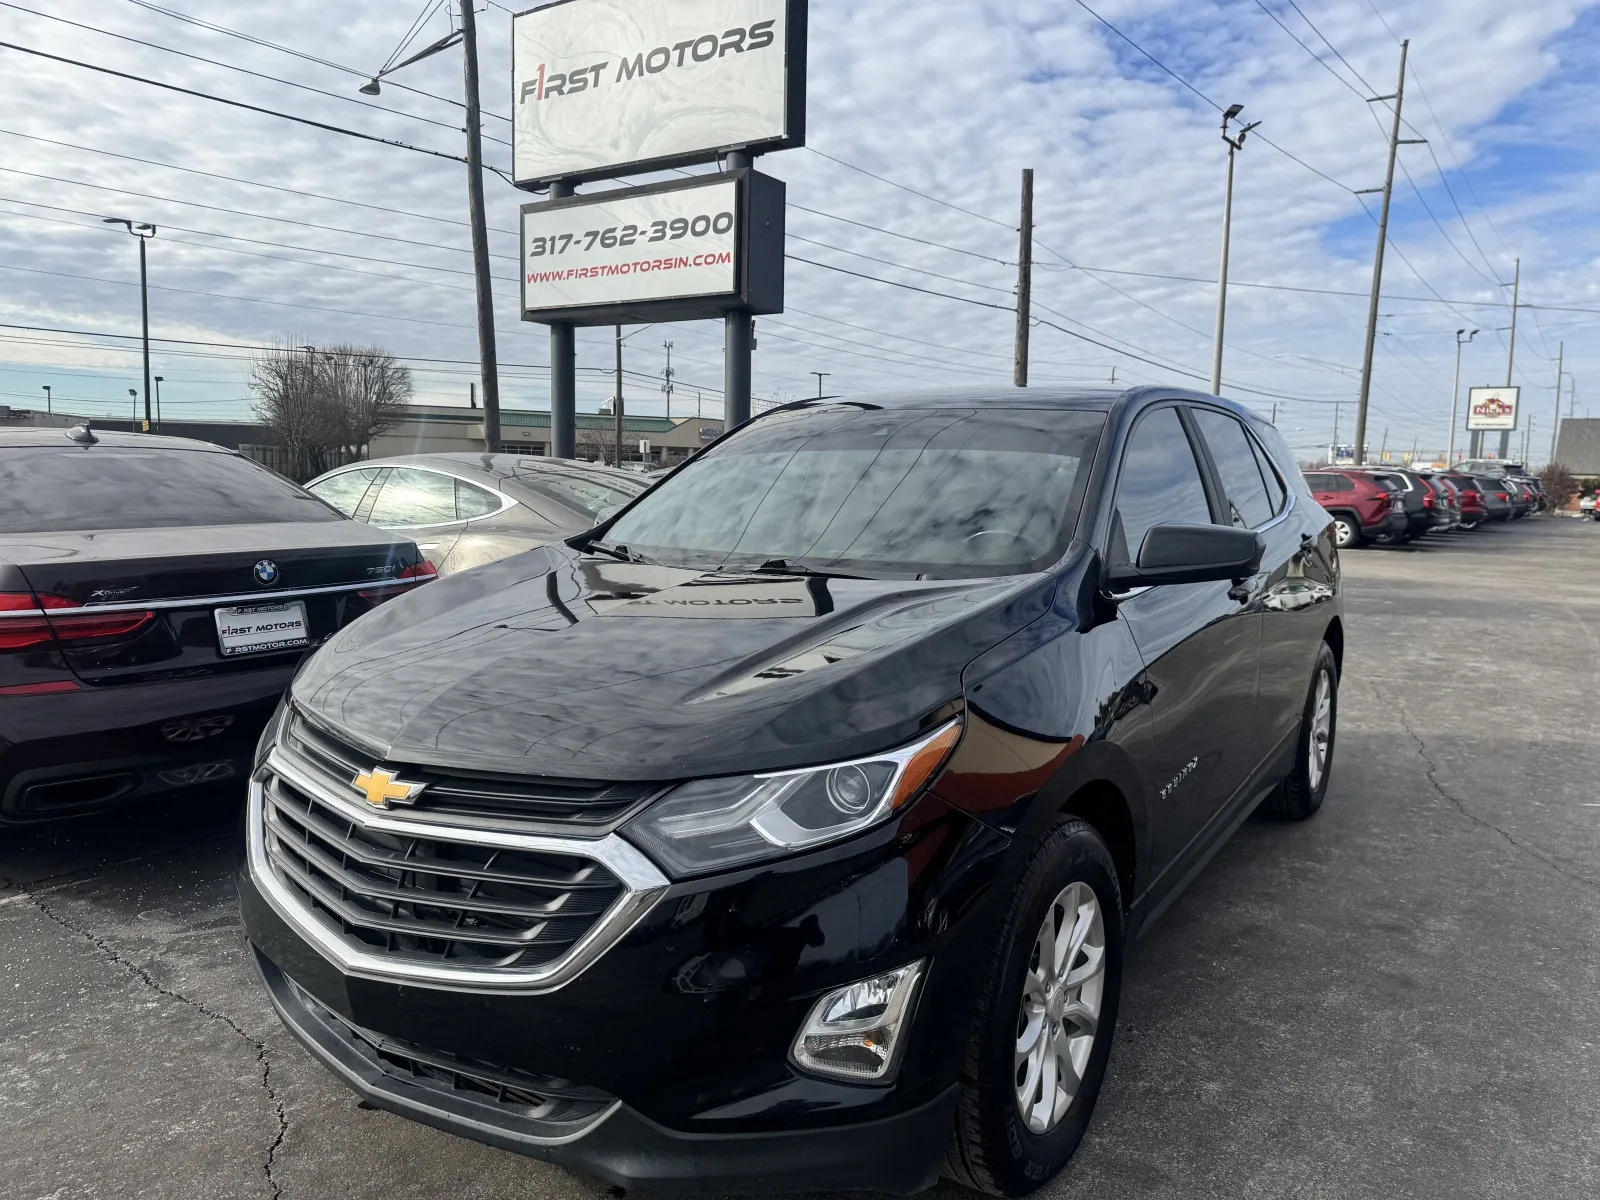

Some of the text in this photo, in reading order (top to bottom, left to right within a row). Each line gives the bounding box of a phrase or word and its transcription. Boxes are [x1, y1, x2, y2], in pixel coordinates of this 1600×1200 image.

[615, 19, 776, 83] MOTORS
[529, 211, 734, 258] 317-762-3900
[526, 251, 731, 284] WWW.FIRSTMOTORSIN.COM
[255, 620, 302, 632] MOTORS
